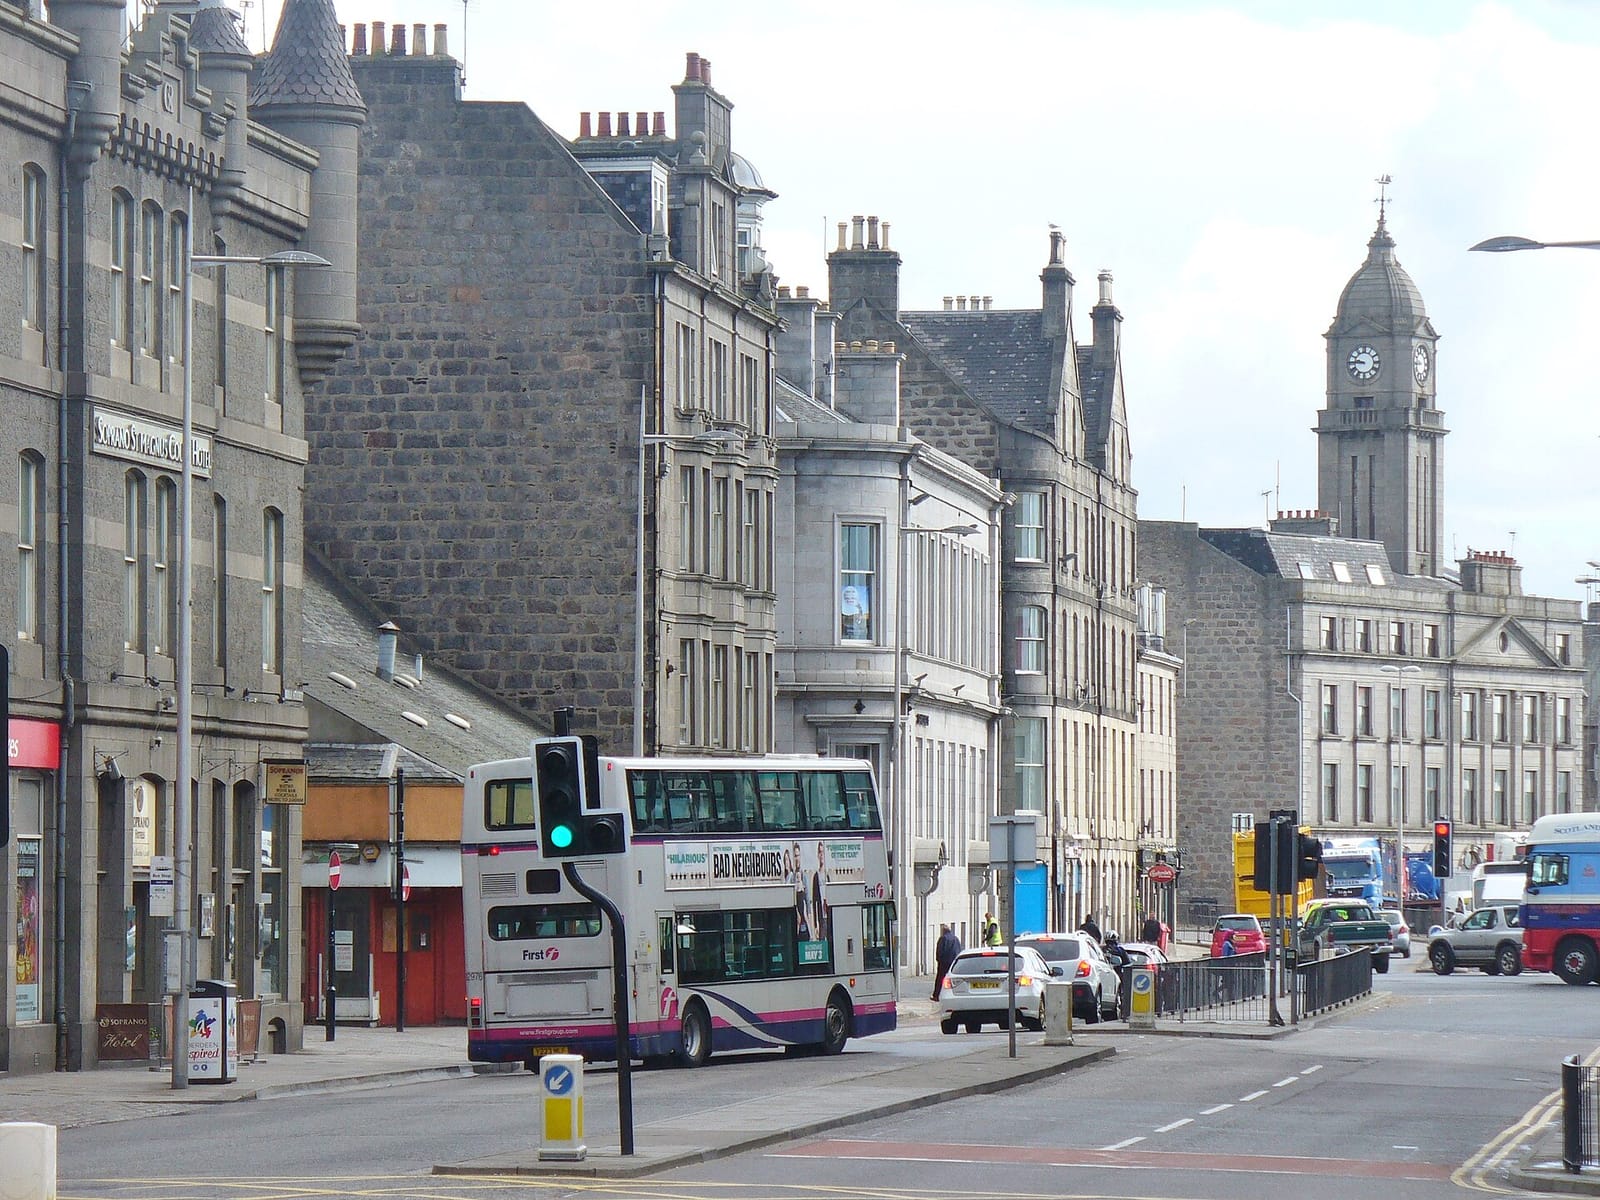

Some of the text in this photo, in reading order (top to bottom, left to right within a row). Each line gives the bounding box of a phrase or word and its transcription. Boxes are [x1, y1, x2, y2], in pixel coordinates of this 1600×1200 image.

[97, 416, 131, 449] SOPRANO
[140, 433, 168, 458] MAGNUS
[192, 439, 211, 467] HOTEL
[713, 851, 782, 879] BAD NEIGHBOURS
[864, 885, 876, 899] First
[522, 950, 545, 960] First
[805, 951, 817, 960] MAY
[110, 1018, 148, 1026] SOPRANOS
[104, 1033, 143, 1047] Hotel
